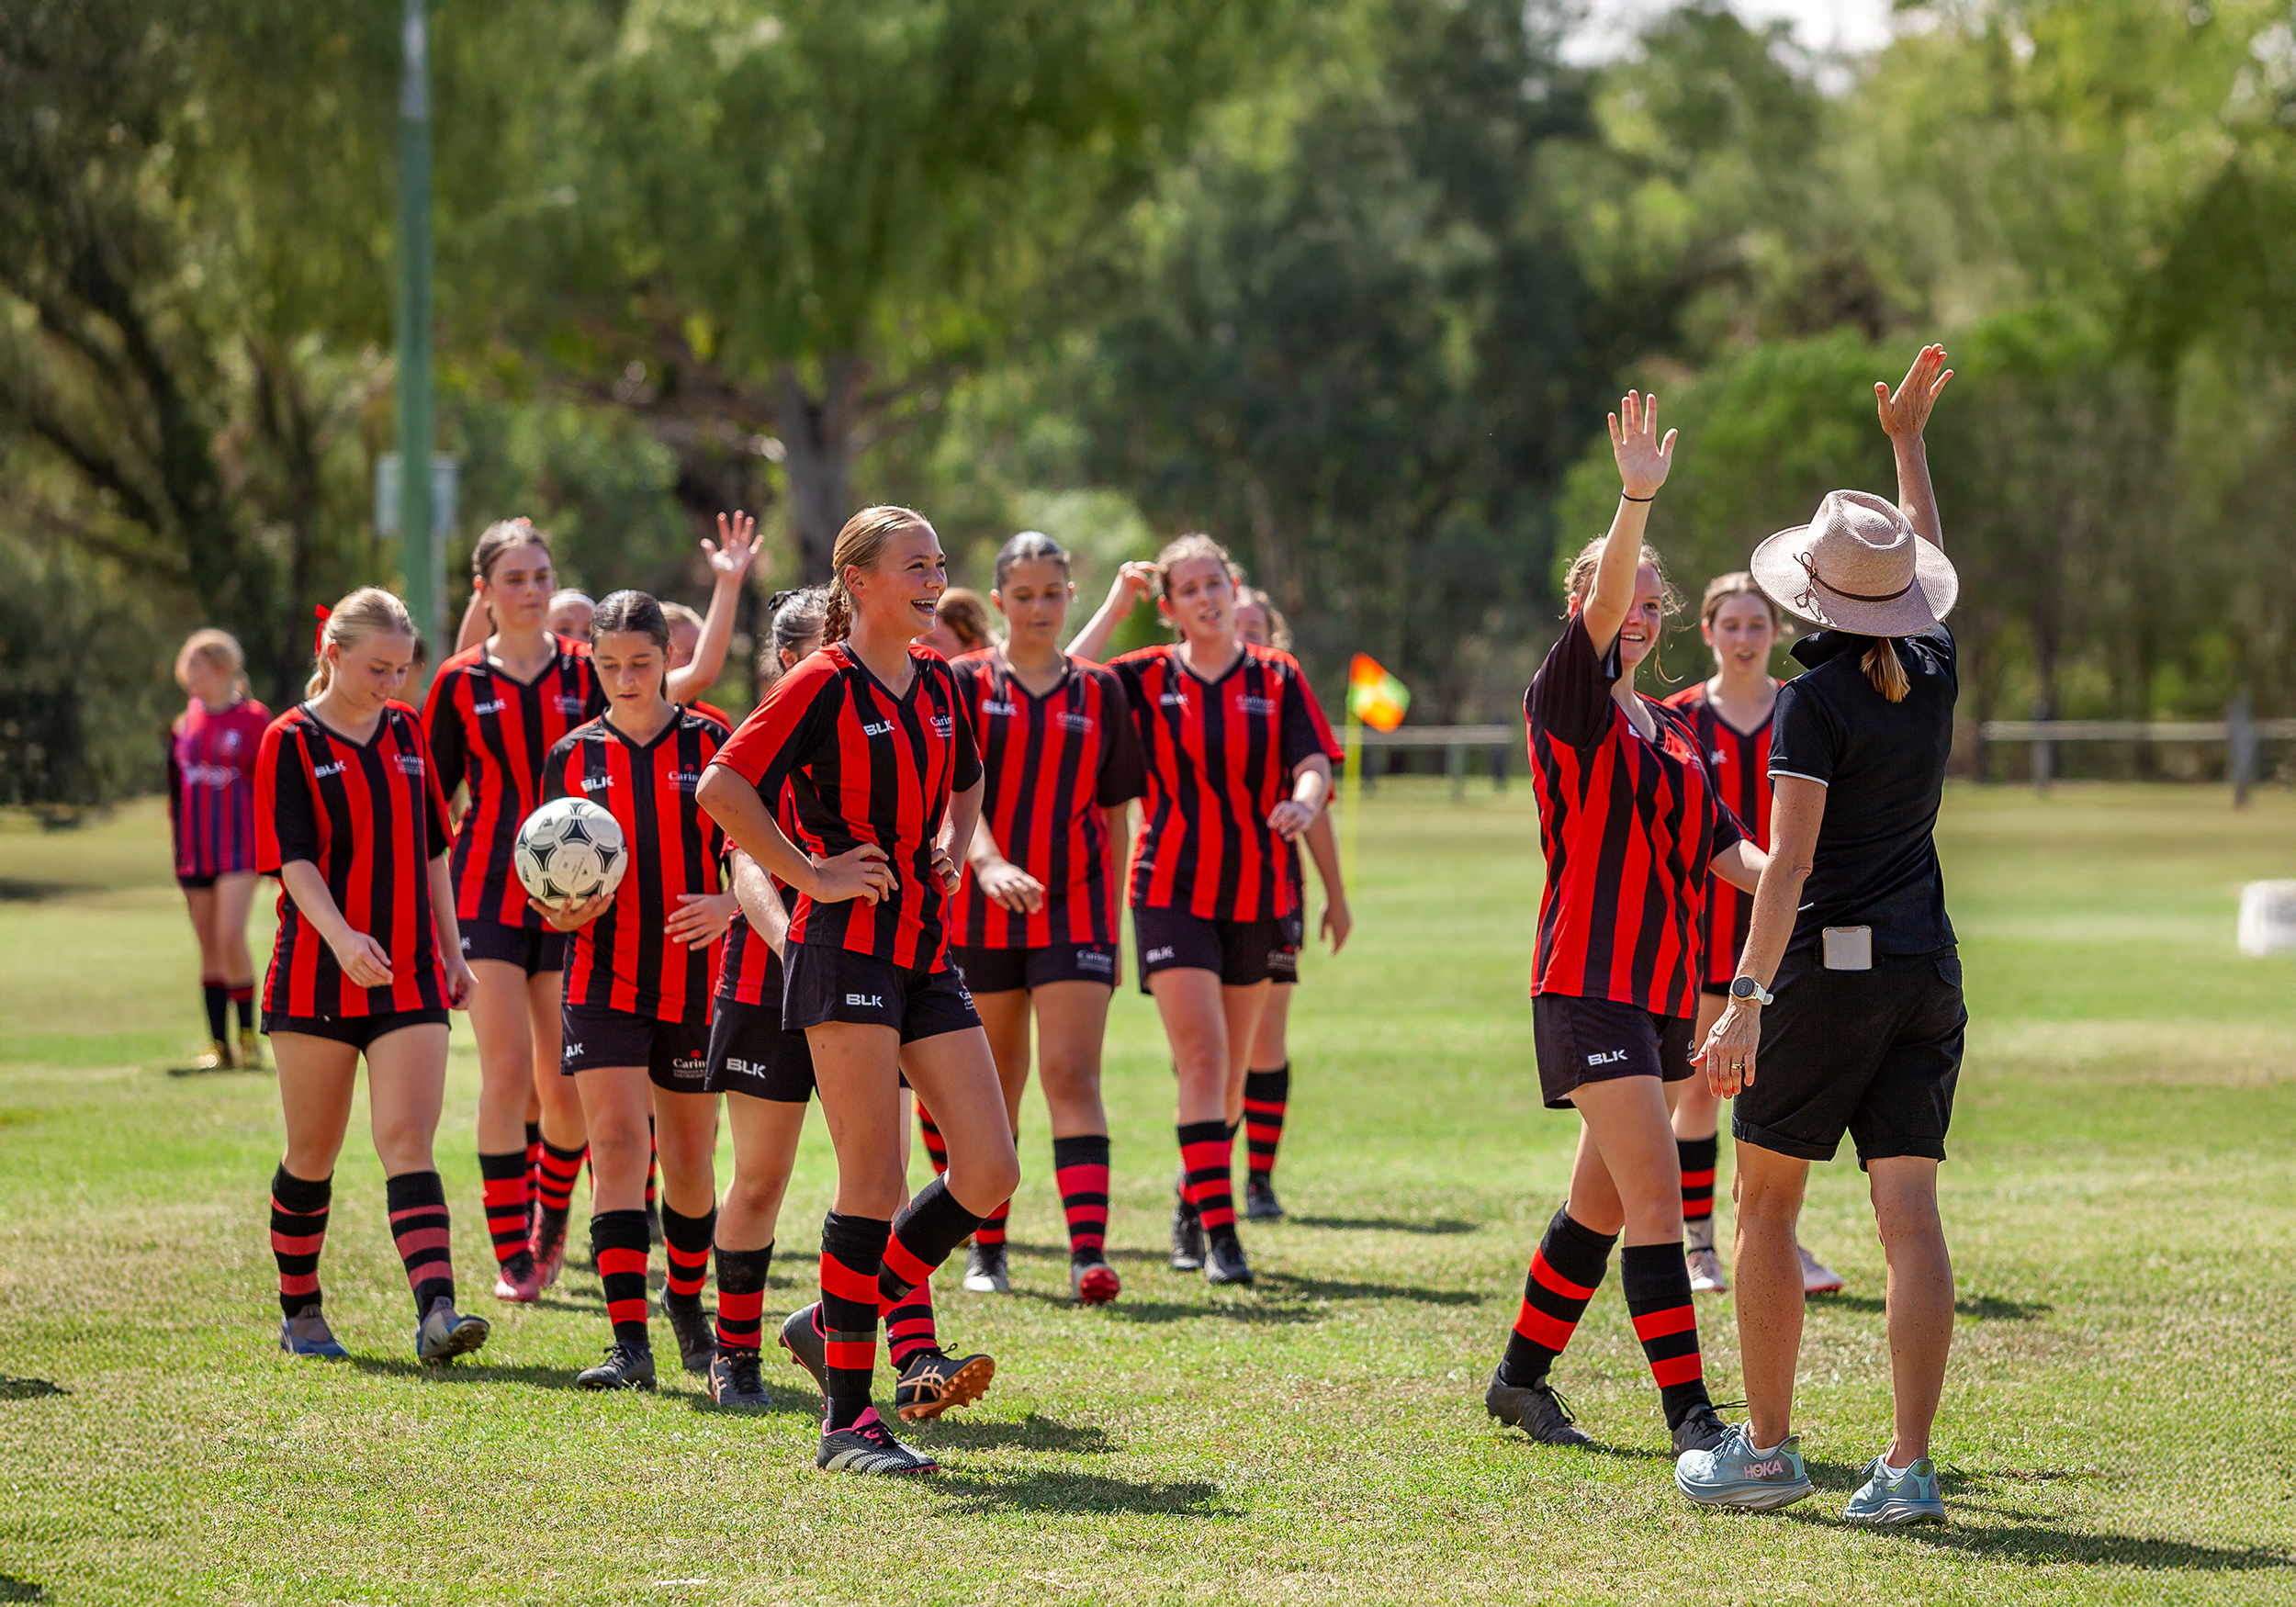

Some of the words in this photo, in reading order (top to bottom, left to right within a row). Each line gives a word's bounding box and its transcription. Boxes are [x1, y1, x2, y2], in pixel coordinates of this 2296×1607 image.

[982, 699, 1018, 716] BLK
[863, 719, 895, 736] BLK
[929, 715, 952, 727] Carin
[314, 759, 347, 779] BLK
[668, 770, 700, 781] Carin
[580, 775, 614, 792] BLK
[846, 994, 884, 1007] BLK
[672, 1057, 706, 1069] Carin
[1587, 1049, 1628, 1066] BLK
[726, 1058, 767, 1079] BLK
[1744, 1459, 1784, 1479] HOKA
